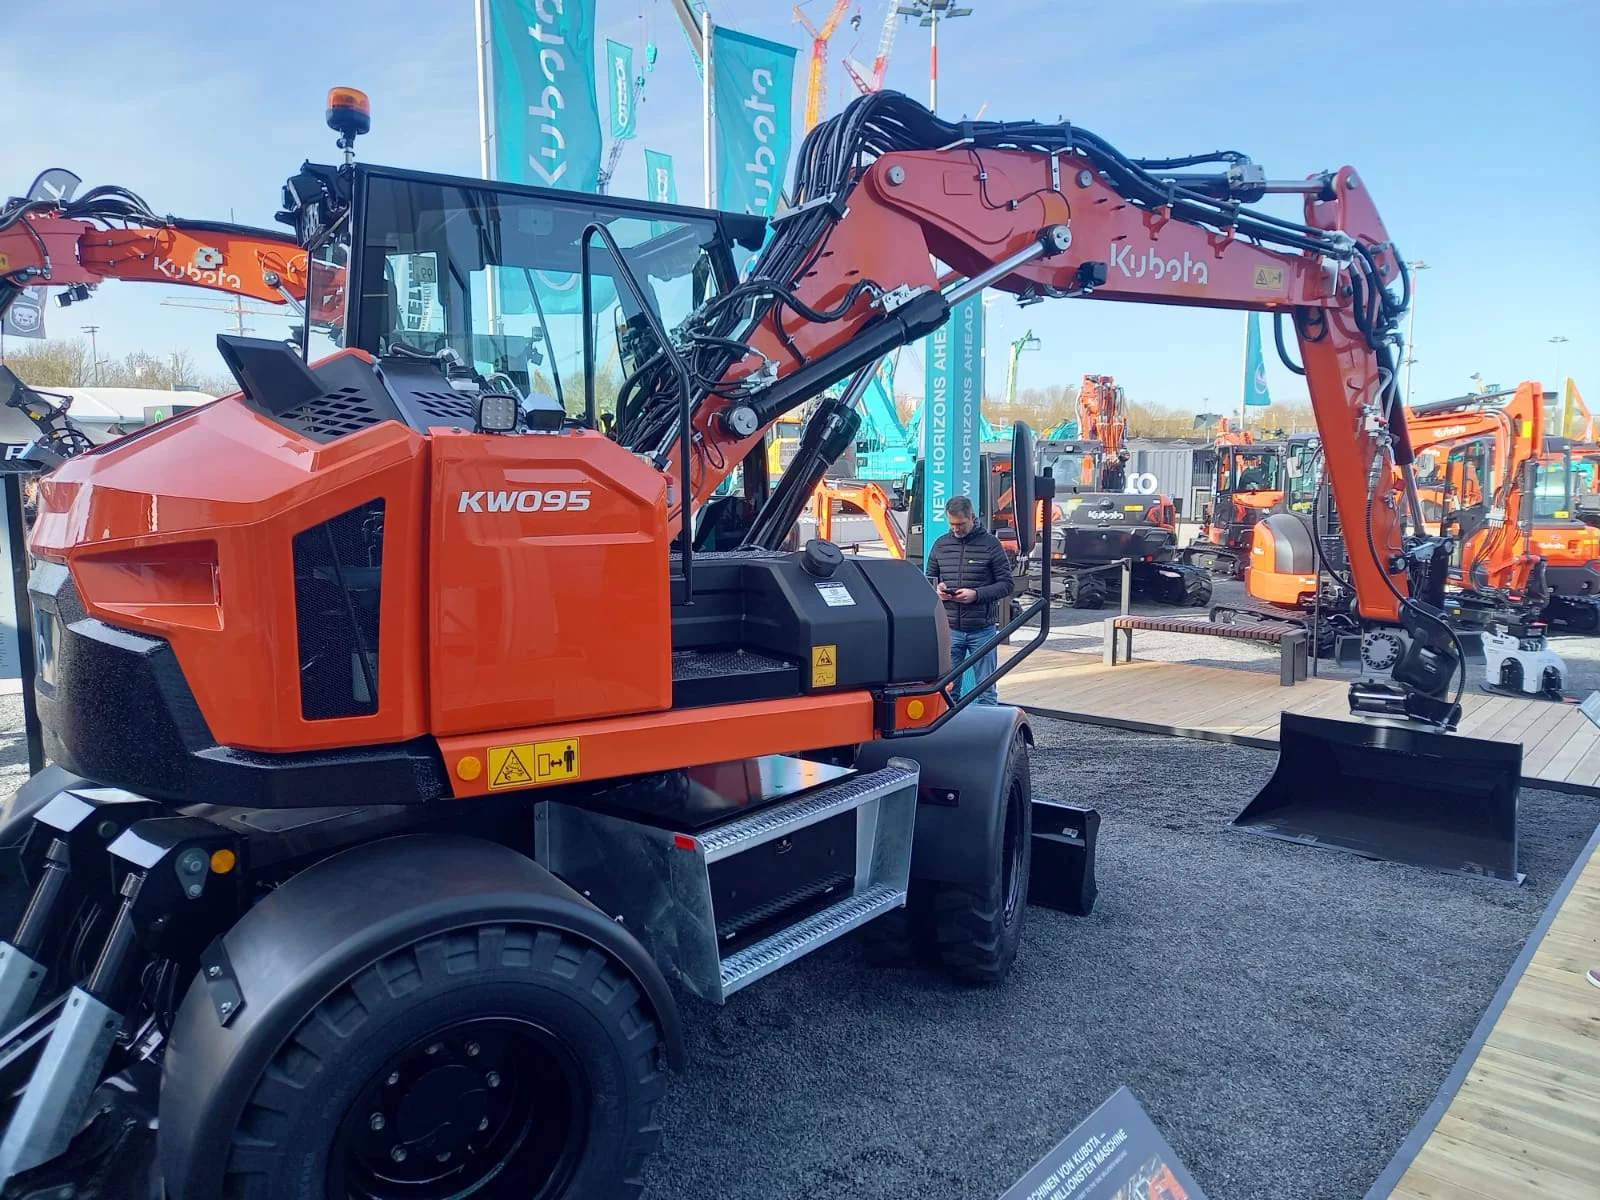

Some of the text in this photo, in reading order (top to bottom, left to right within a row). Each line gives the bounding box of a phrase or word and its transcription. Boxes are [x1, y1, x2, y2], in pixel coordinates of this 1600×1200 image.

[744, 68, 776, 213] ubota
[153, 256, 241, 289] Kubota
[1110, 243, 1208, 285] Kubota
[964, 301, 974, 372] AHEAD.
[933, 325, 946, 522] NEW HORIZONS AHE
[963, 377, 972, 474] HORIZONS
[458, 490, 592, 513] KW095
[1056, 1158, 1076, 1179] VON
[1072, 1135, 1102, 1165] KUBOTA
[1093, 1128, 1128, 1166] MASCHINE
